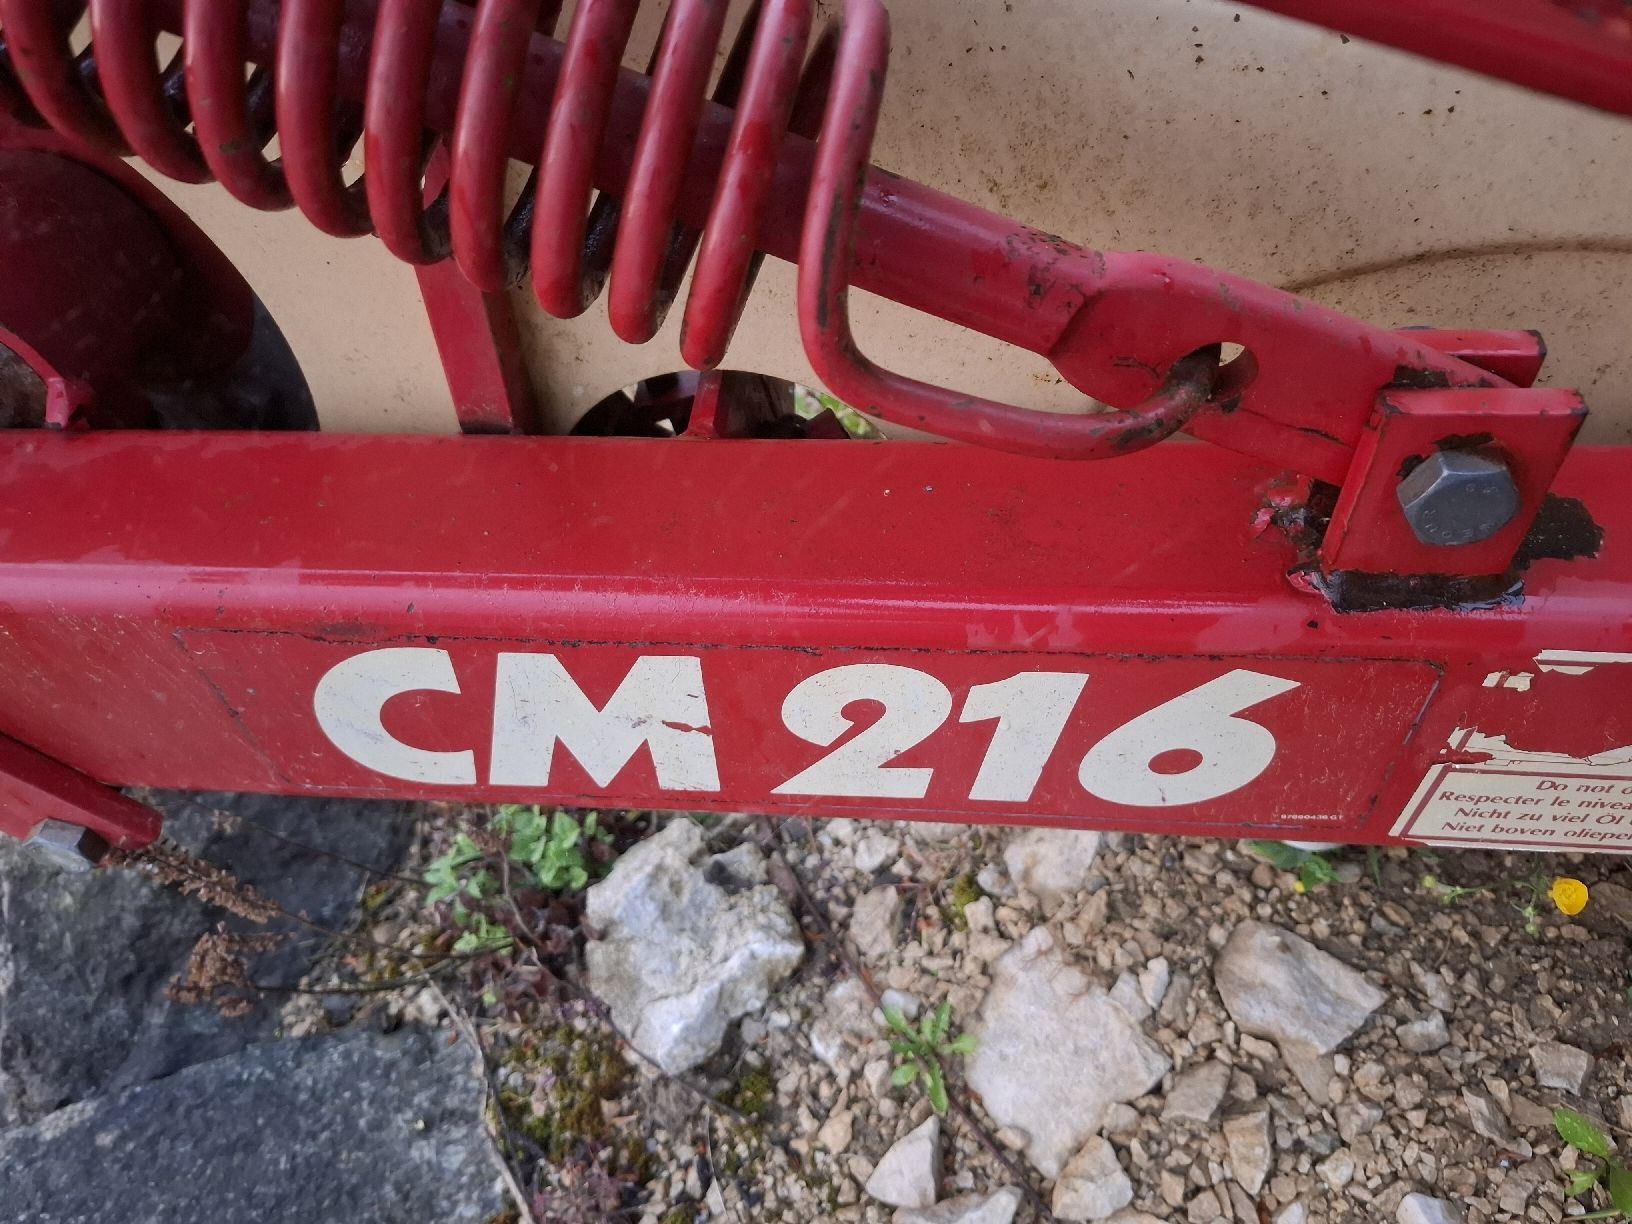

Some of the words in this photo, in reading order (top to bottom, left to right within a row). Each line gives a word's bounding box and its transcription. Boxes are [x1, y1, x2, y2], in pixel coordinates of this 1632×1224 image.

[314, 647, 720, 792] CM
[770, 664, 1301, 807] 216
[1536, 779, 1569, 792] Do
[1576, 784, 1615, 793] not
[1438, 791, 1544, 806] Respecter
[1550, 796, 1570, 807] le
[1454, 807, 1511, 819] Nicht
[1516, 812, 1544, 822] zu
[1552, 812, 1590, 823] viel
[1596, 812, 1625, 825] Öl
[1441, 821, 1485, 833] Niet
[1490, 823, 1556, 836] boven
